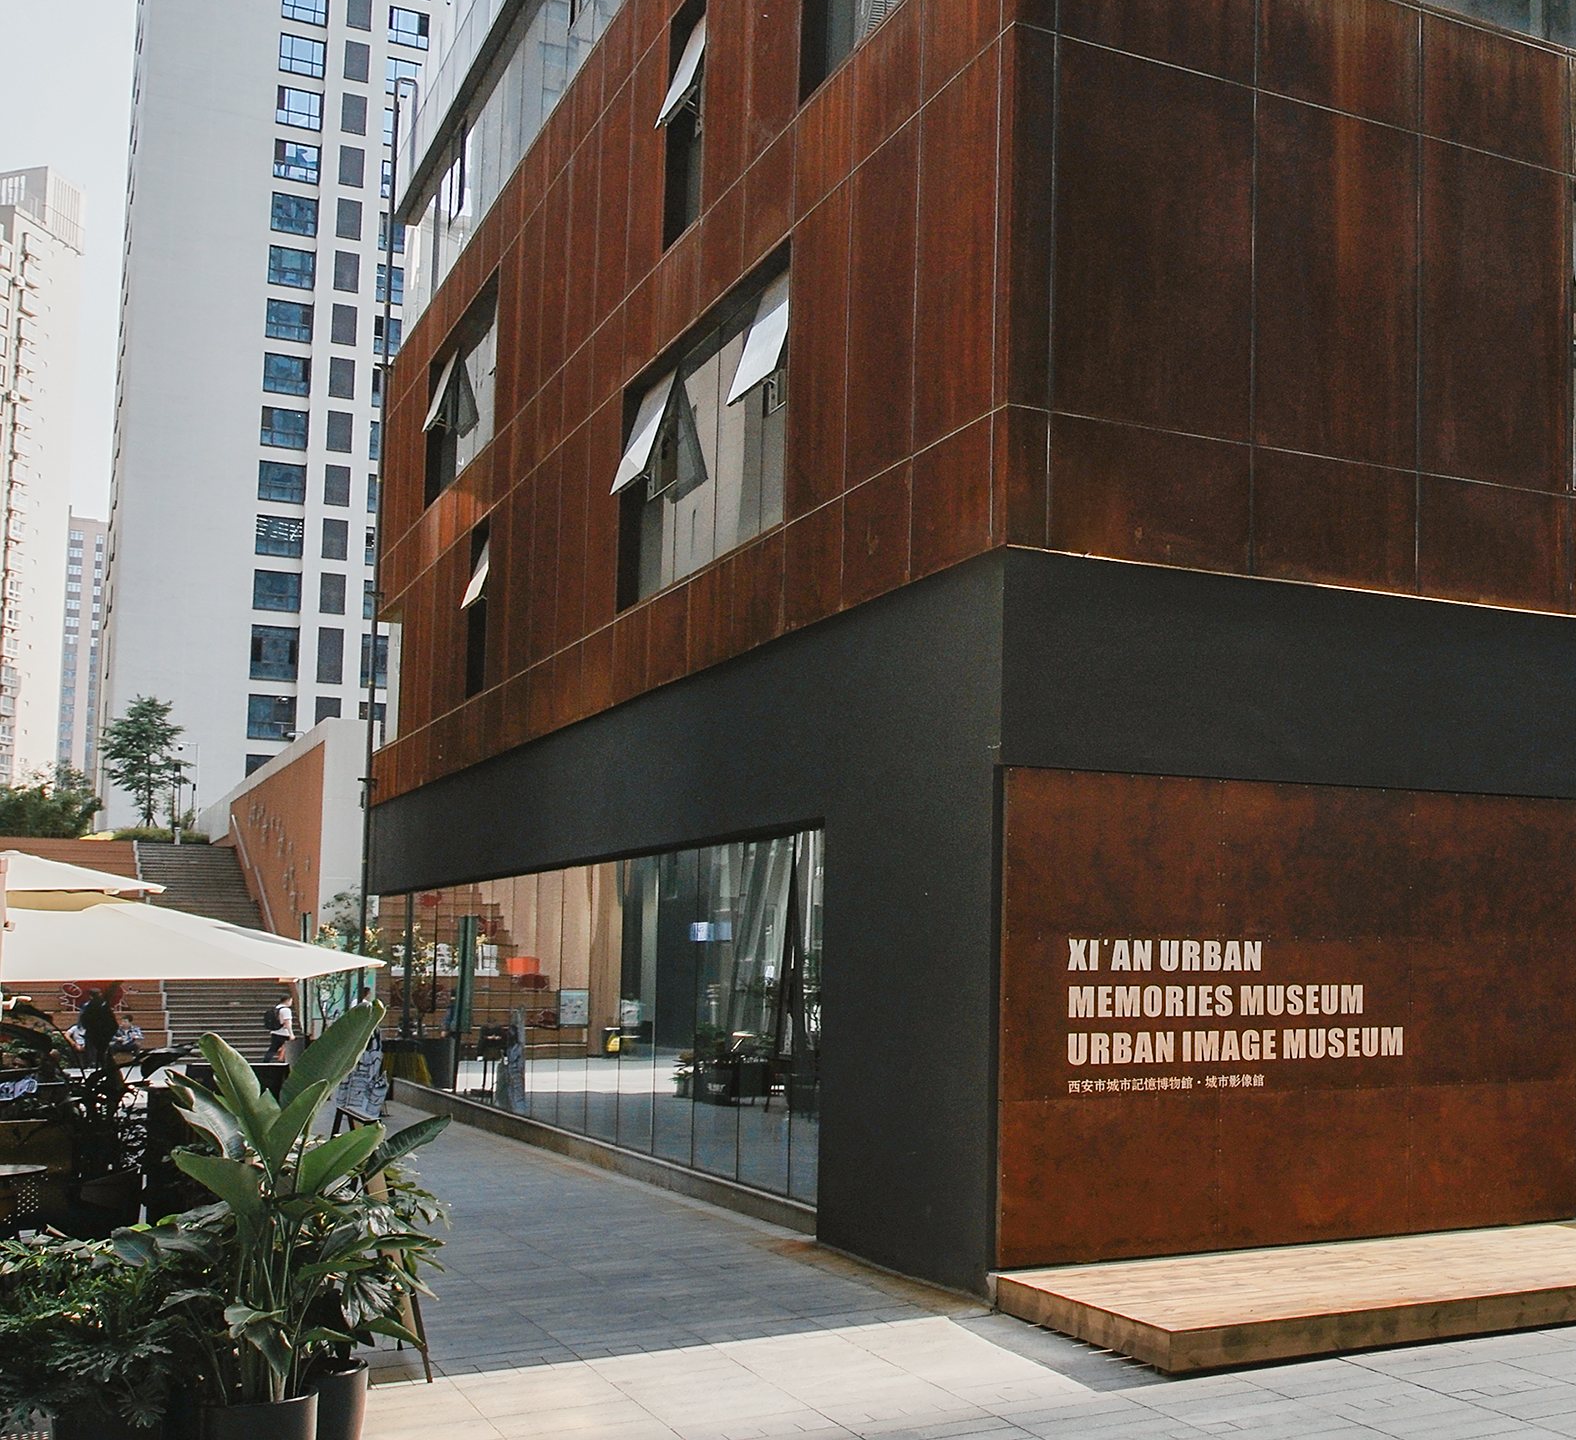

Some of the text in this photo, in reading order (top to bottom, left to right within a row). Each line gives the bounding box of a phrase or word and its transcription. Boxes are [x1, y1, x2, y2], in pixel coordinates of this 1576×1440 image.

[1067, 938, 1263, 971] XI'AN URBAN
[1068, 983, 1364, 1018] MEMORIES MUSEUM
[1067, 1026, 1405, 1065] URBAN IMAGE MUSEUM
